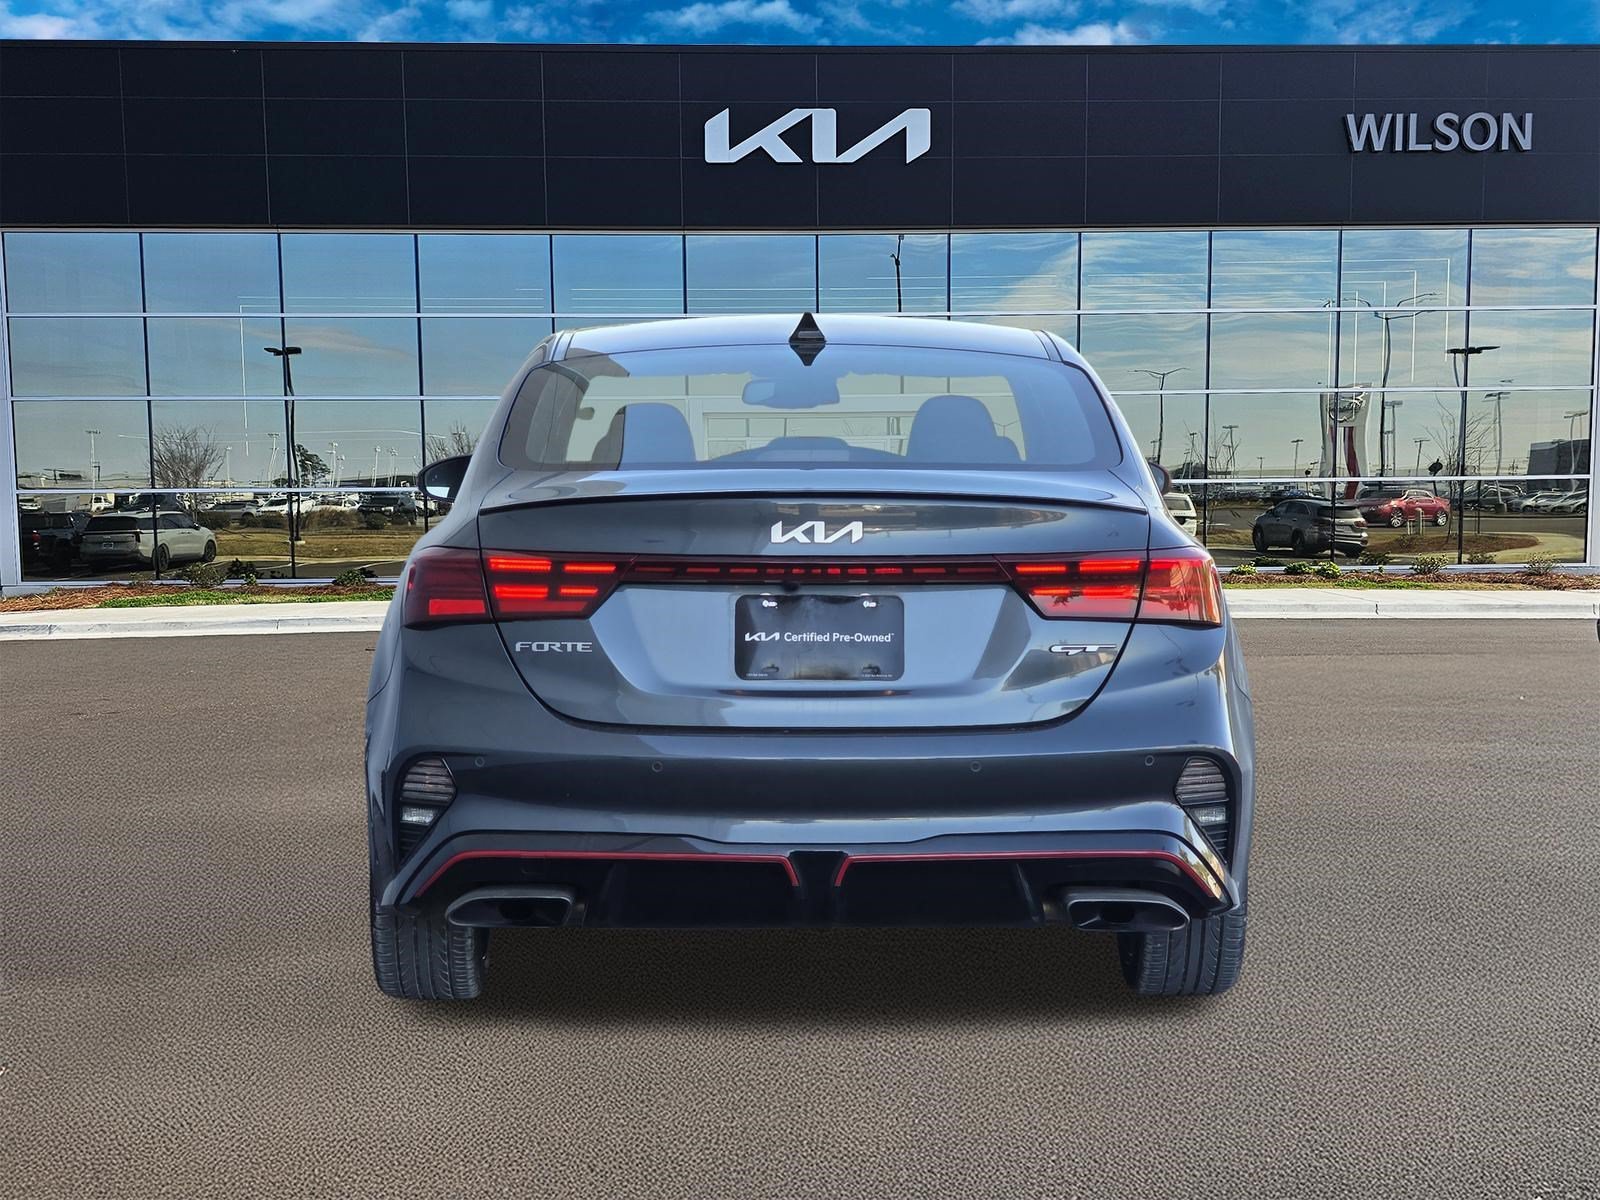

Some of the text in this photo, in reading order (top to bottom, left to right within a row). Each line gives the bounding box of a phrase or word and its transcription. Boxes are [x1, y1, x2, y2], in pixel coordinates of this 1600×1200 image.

[704, 107, 932, 164] KIA
[1344, 111, 1534, 153] WILSON
[770, 520, 863, 544] KIA
[783, 631, 830, 642] Certified
[515, 641, 593, 653] FORTE
[1050, 644, 1117, 656] GT
